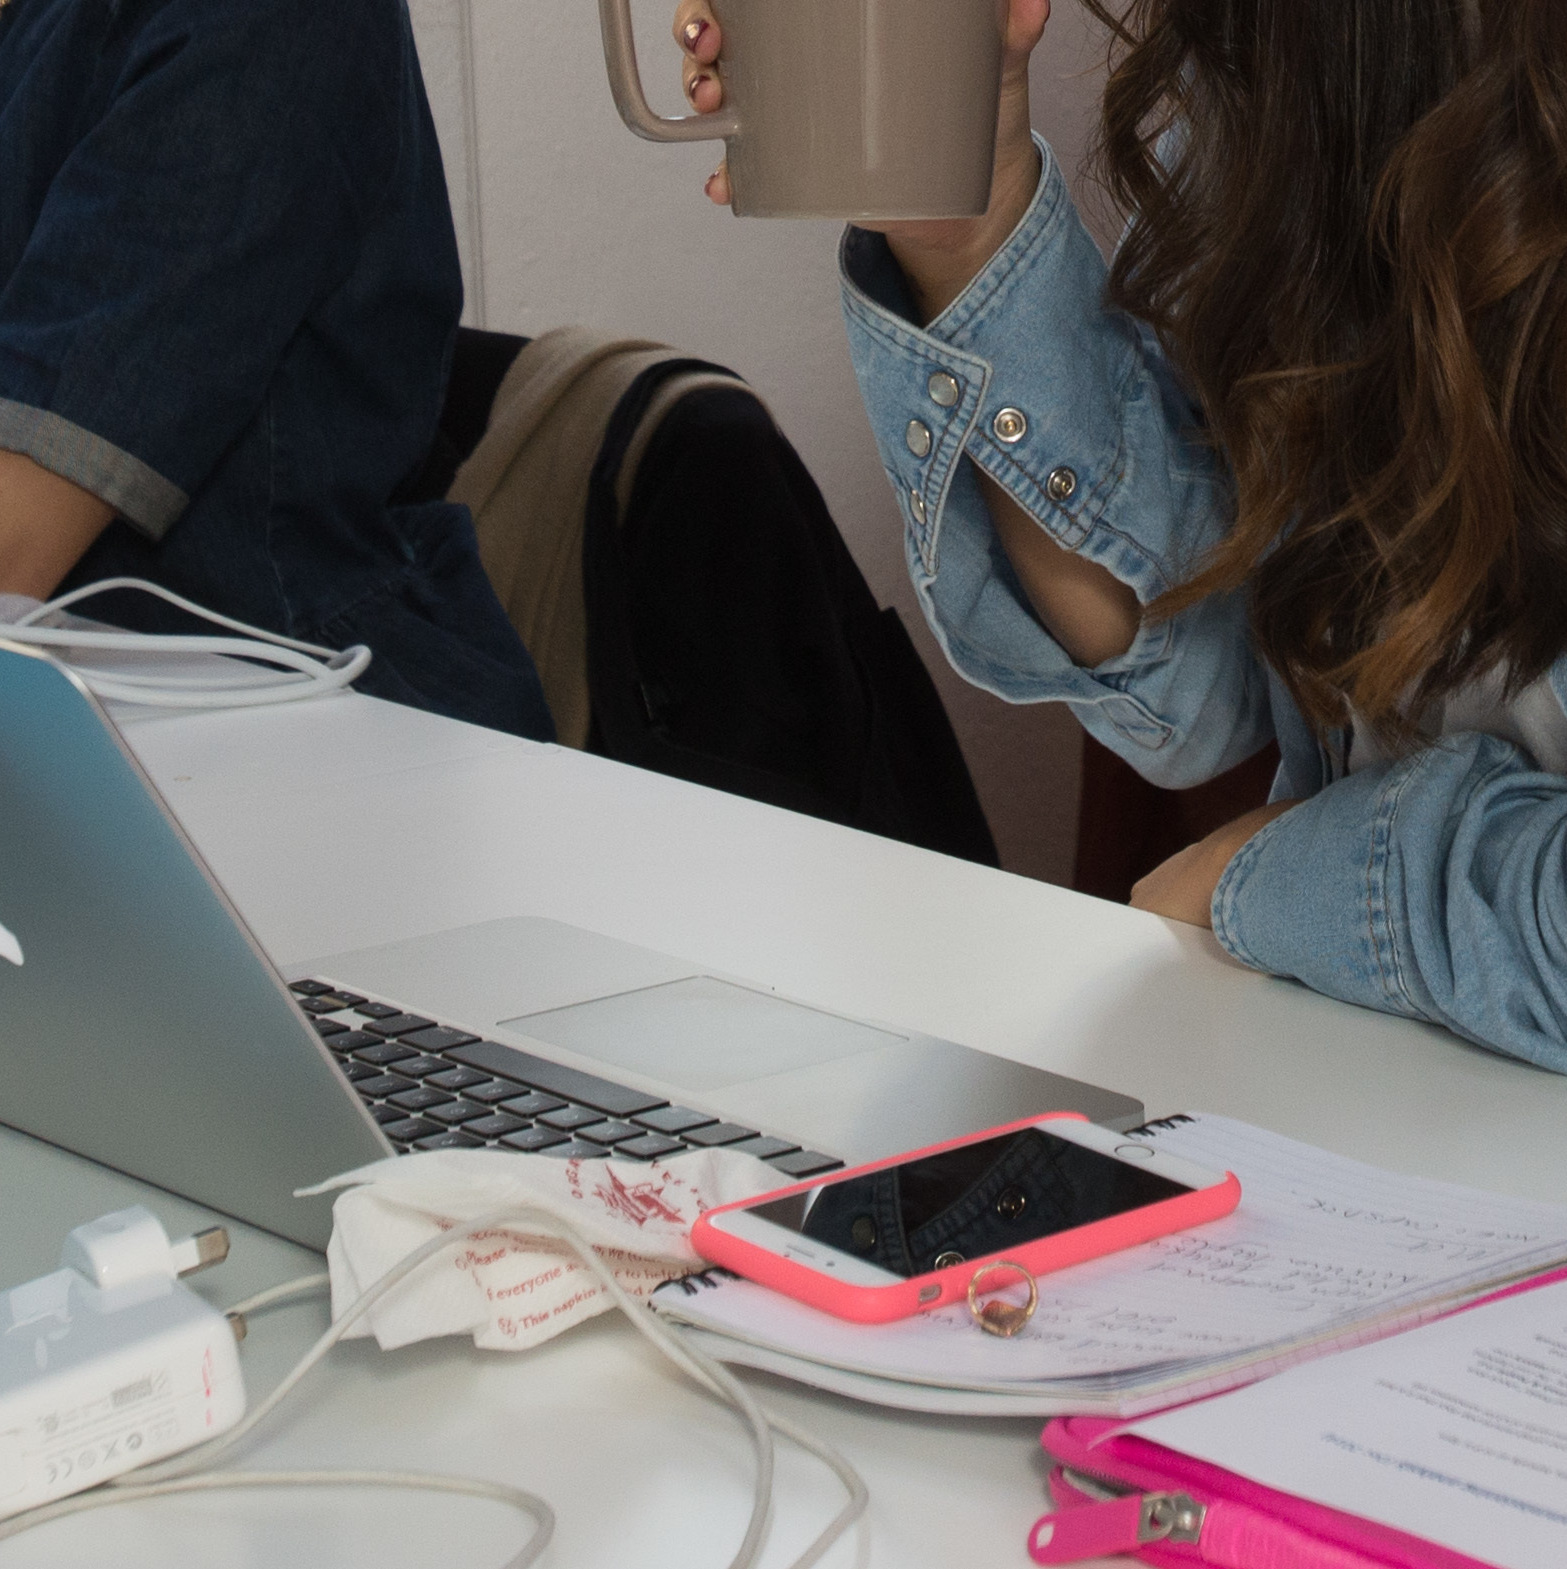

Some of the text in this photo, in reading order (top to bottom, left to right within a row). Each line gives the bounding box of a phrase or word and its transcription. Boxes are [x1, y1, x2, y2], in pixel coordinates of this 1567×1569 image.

[496, 1267, 562, 1299] everyone
[519, 1311, 550, 1330] This
[553, 1285, 597, 1315] napkin
